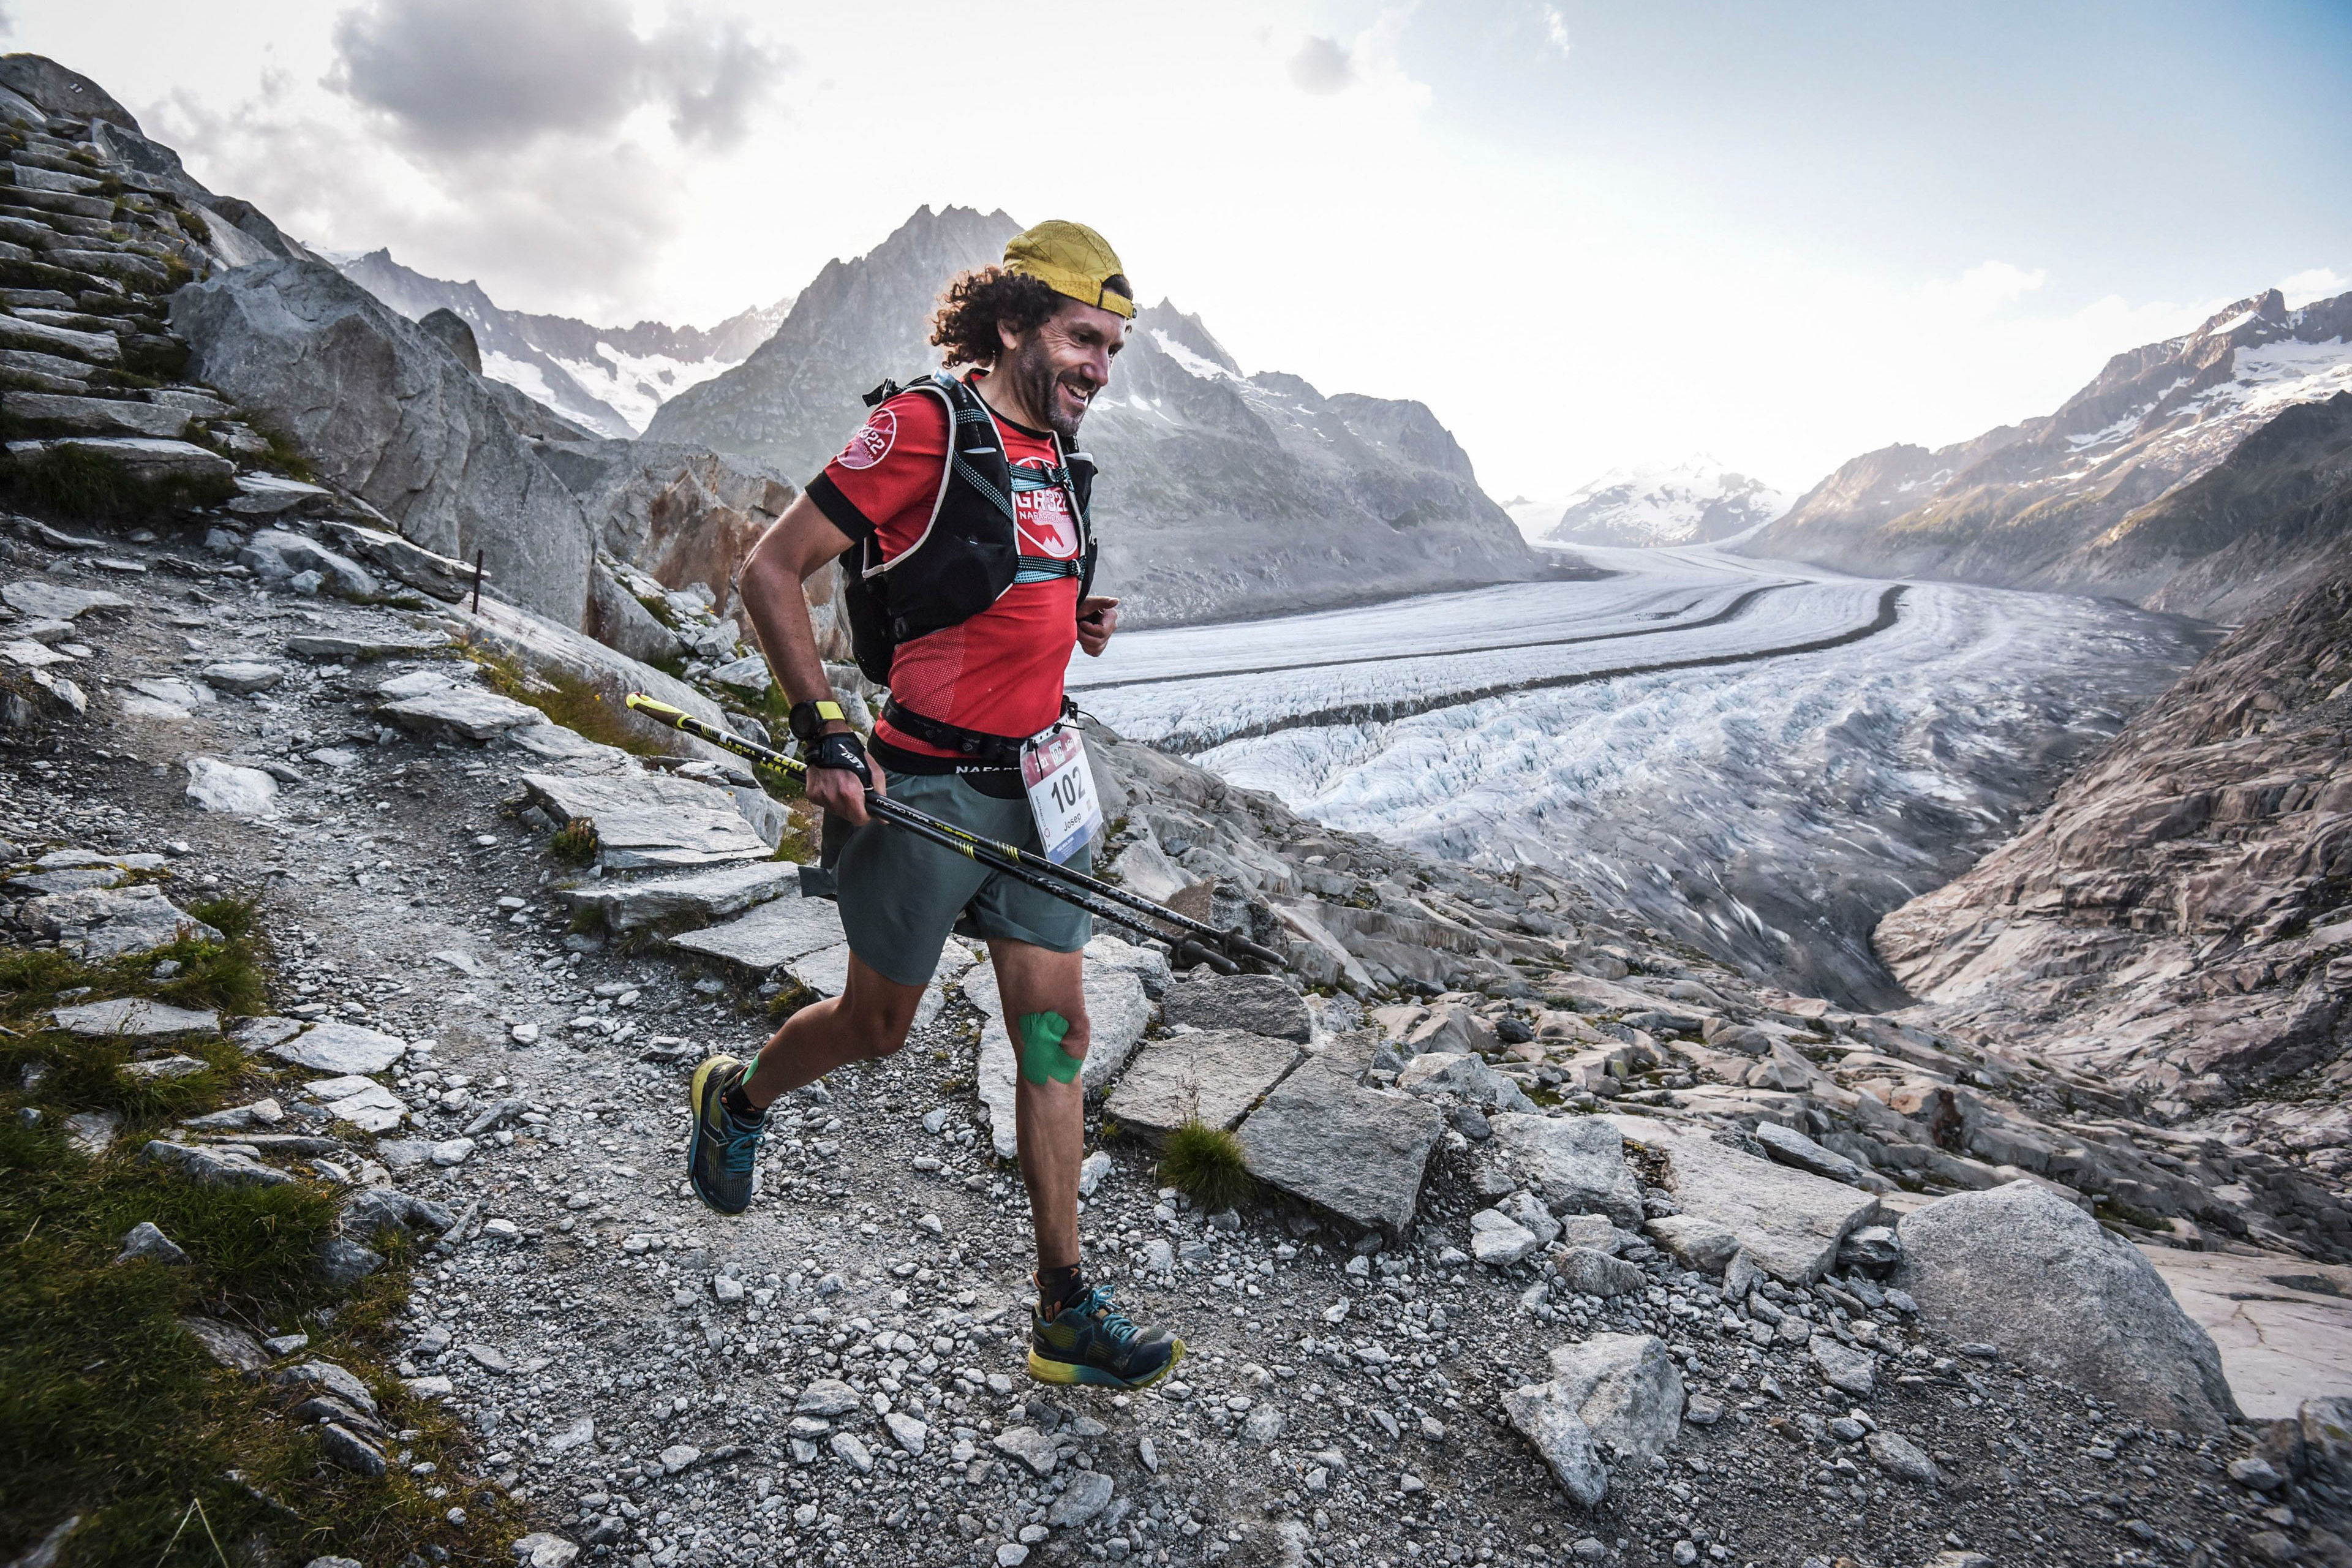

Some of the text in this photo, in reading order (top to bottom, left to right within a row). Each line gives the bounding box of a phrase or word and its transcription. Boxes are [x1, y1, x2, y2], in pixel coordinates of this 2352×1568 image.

[774, 755, 806, 772] LEKI
[1051, 766, 1086, 814] 102
[1064, 813, 1082, 832] Josep
